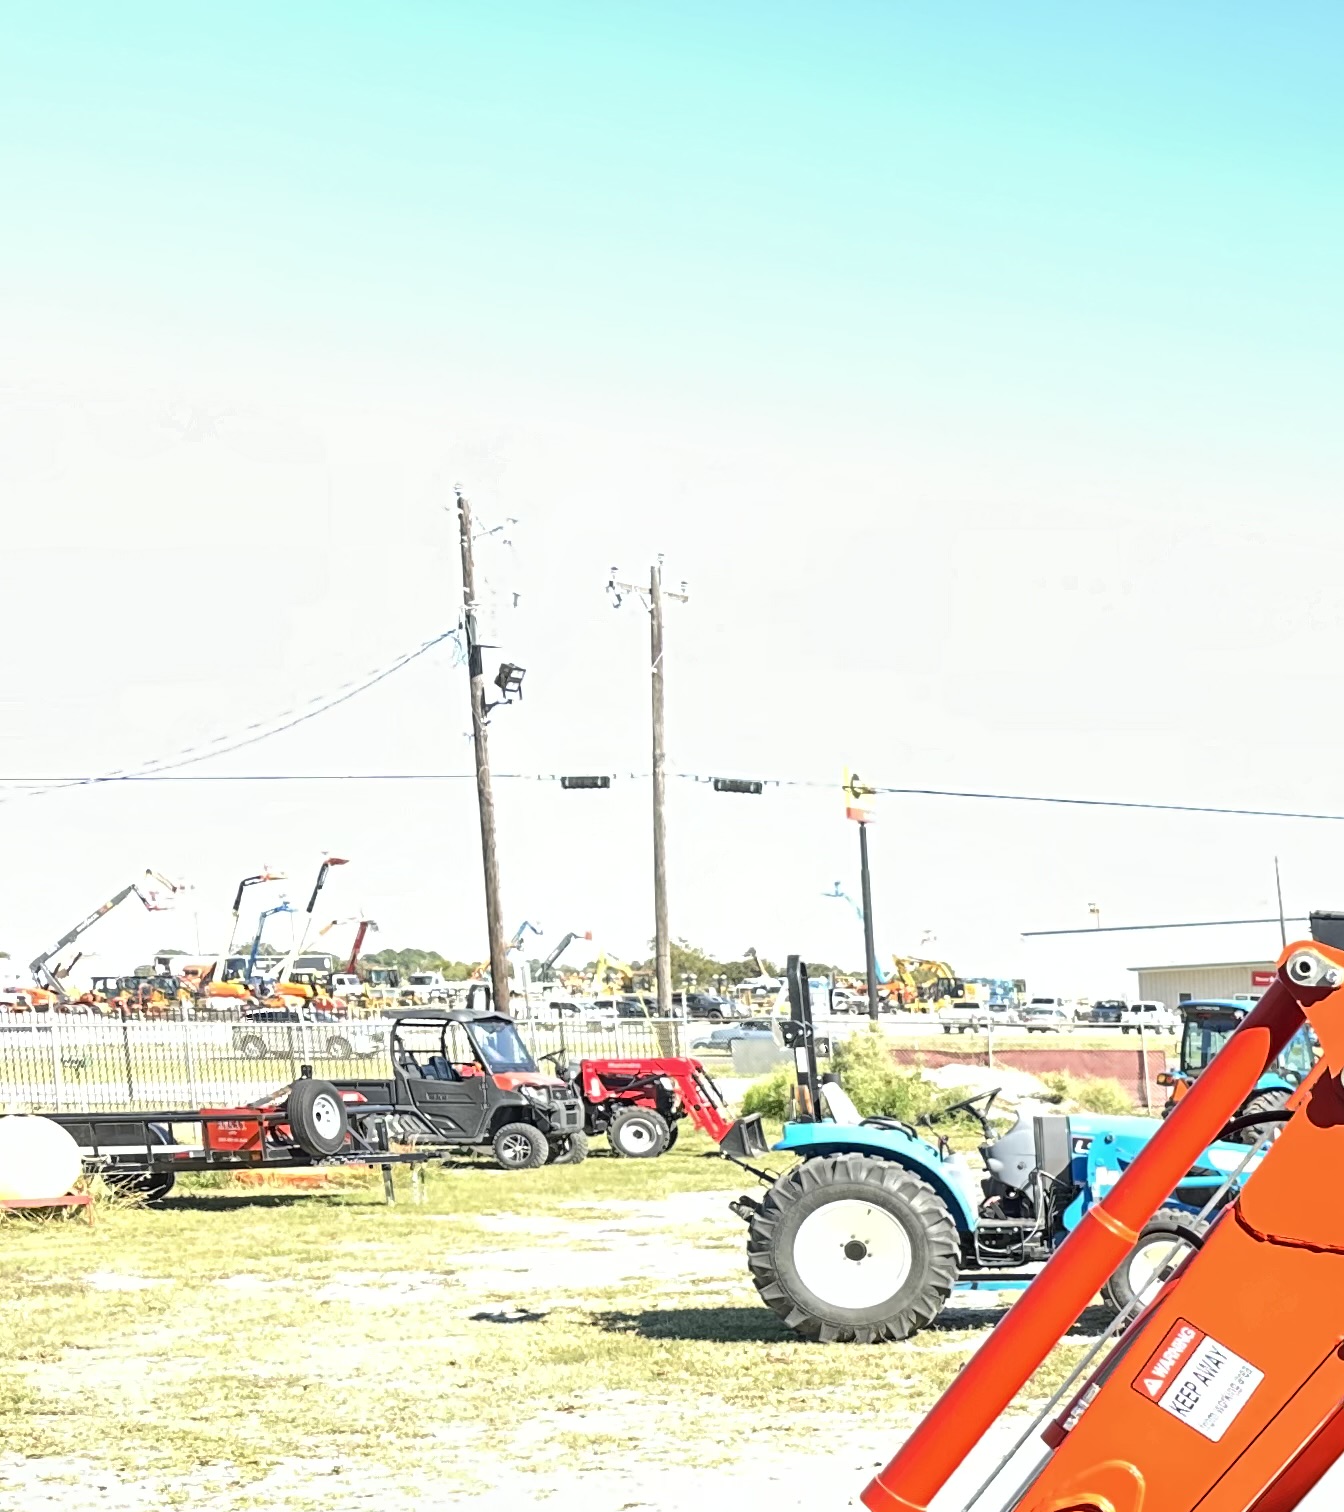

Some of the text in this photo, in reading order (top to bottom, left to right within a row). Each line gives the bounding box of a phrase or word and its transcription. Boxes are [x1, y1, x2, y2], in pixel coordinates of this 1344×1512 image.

[1151, 1326, 1197, 1378] WARNING
[1168, 1344, 1228, 1418] KEEP AWAY
